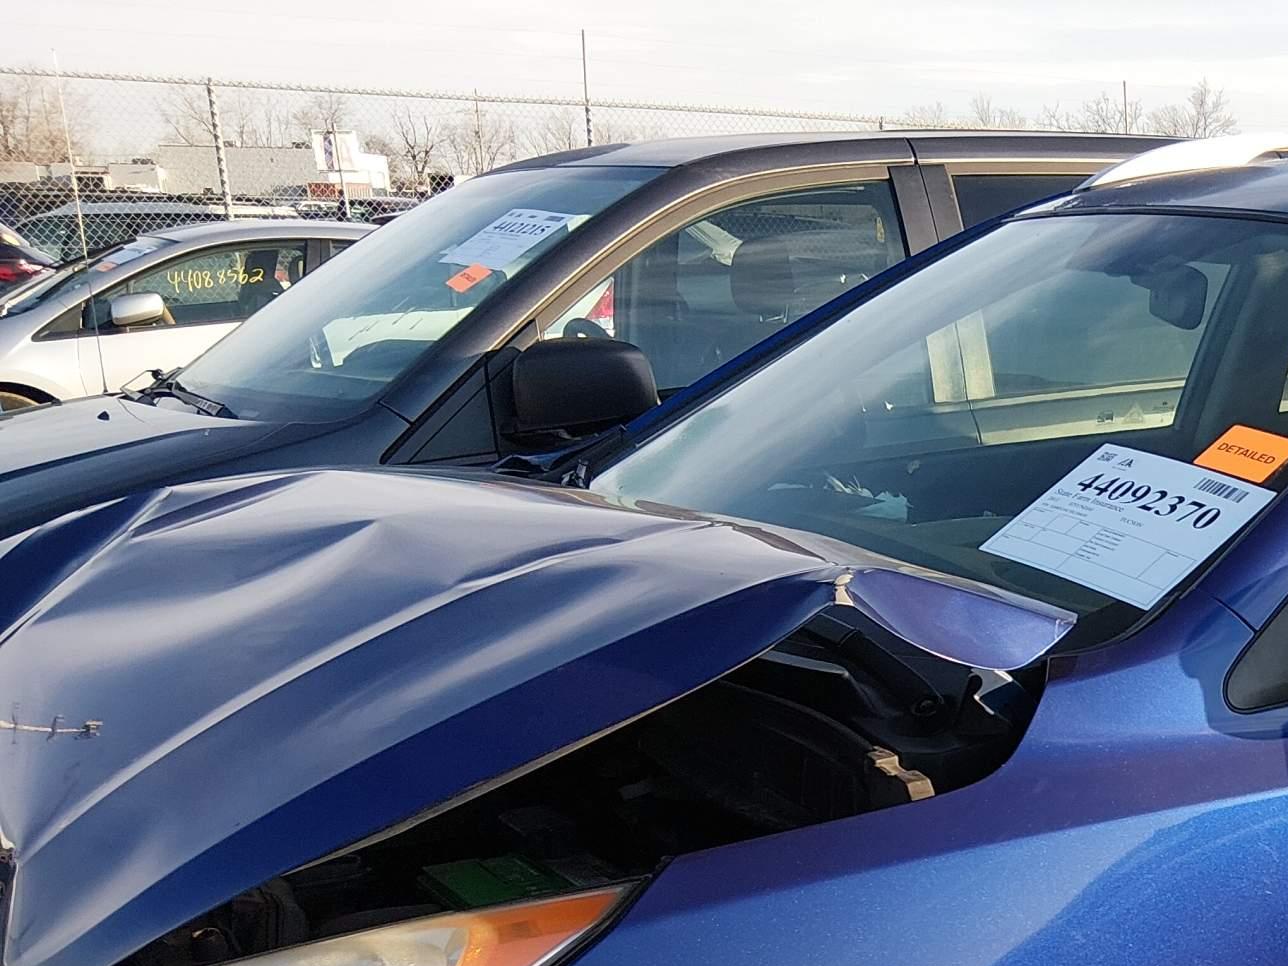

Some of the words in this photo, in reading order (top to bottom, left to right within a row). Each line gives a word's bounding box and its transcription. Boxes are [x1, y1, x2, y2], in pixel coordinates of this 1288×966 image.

[1217, 442, 1276, 464] DETAILED
[1072, 492, 1091, 502] Farm
[1090, 498, 1125, 512] Insurance
[1077, 473, 1221, 530] 44092370
